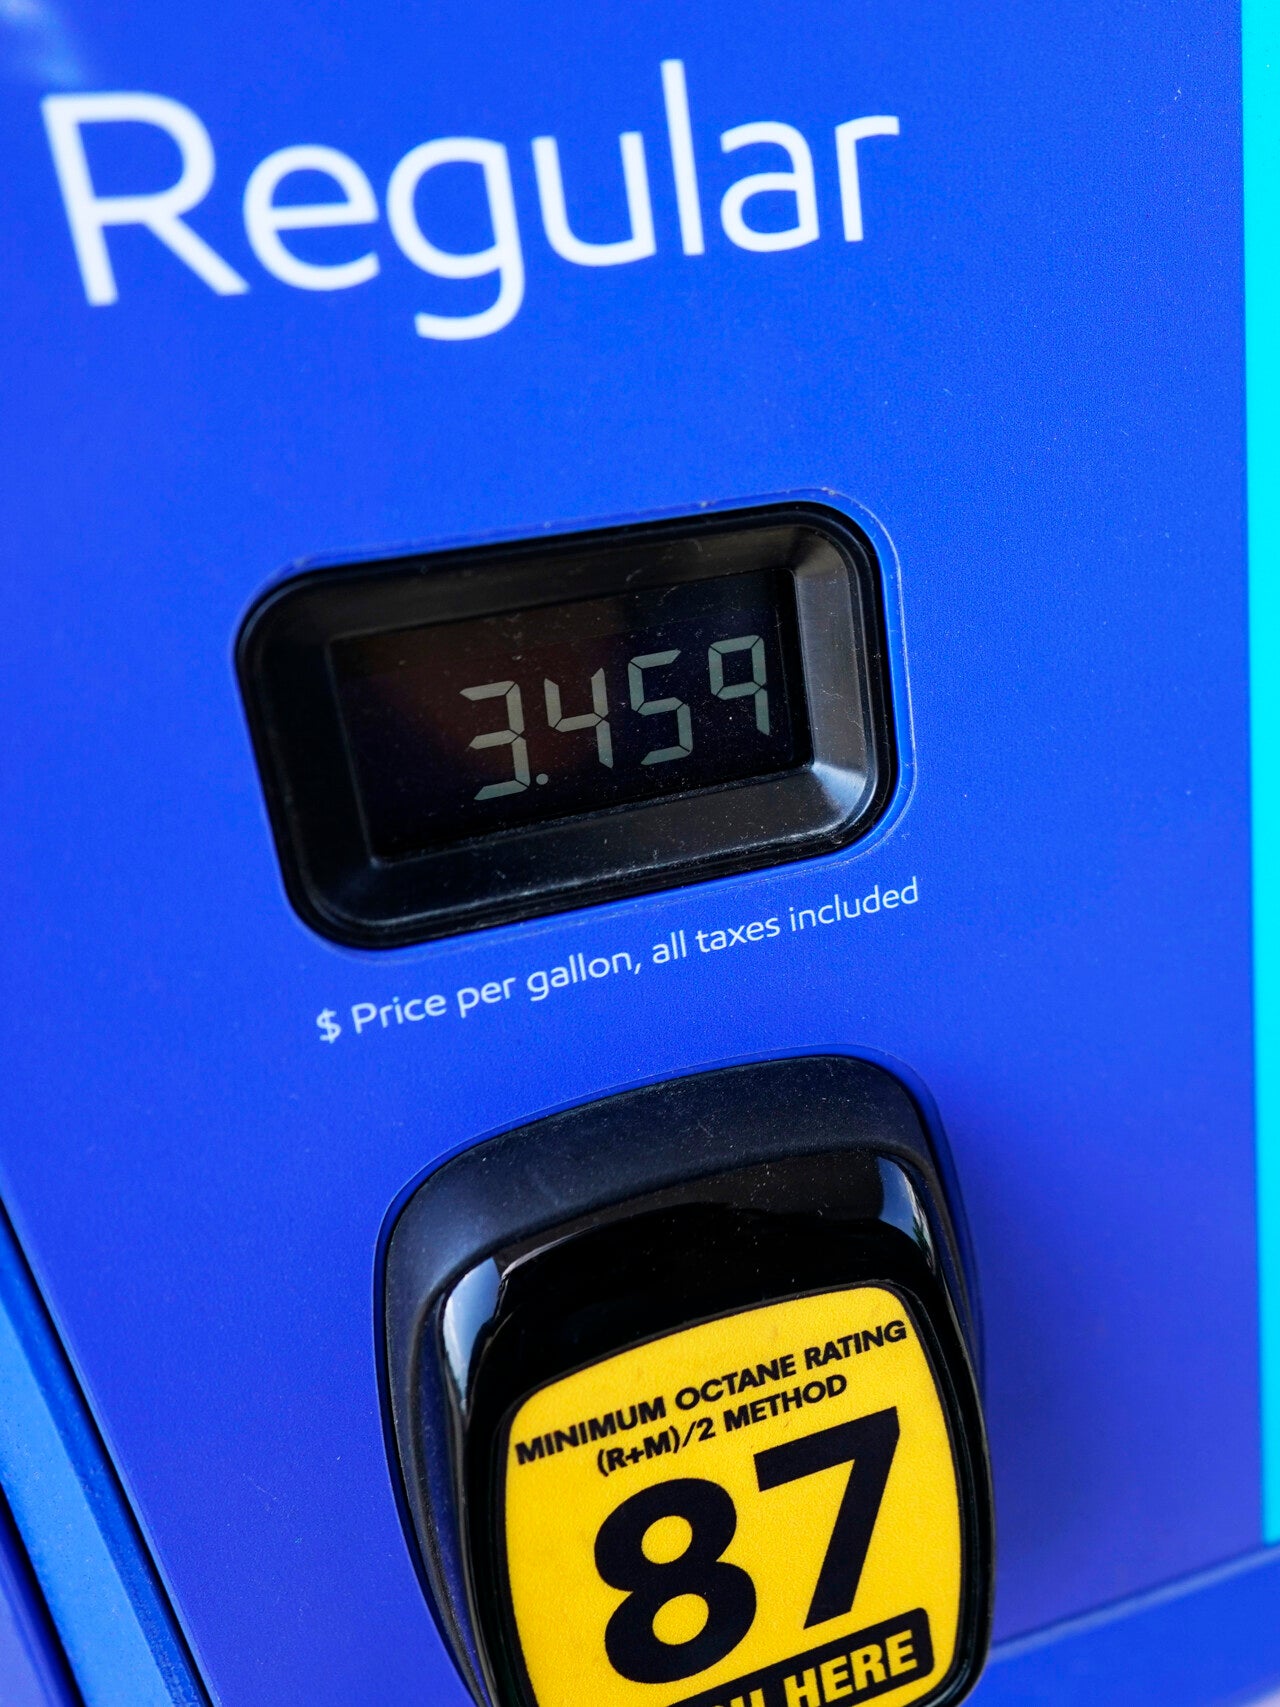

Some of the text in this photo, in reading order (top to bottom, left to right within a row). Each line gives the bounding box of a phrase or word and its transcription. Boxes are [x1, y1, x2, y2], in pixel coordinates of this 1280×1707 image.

[41, 59, 900, 341] Regular
[459, 634, 770, 800] 3.459
[316, 877, 920, 1044] $ Price per gallon, all taxes included
[515, 1320, 907, 1465] MINIMUM OCTANE RATING
[597, 1374, 847, 1477] (R+M)/2 METHOD
[594, 1406, 901, 1684] 87
[783, 1630, 918, 1707] HERE
